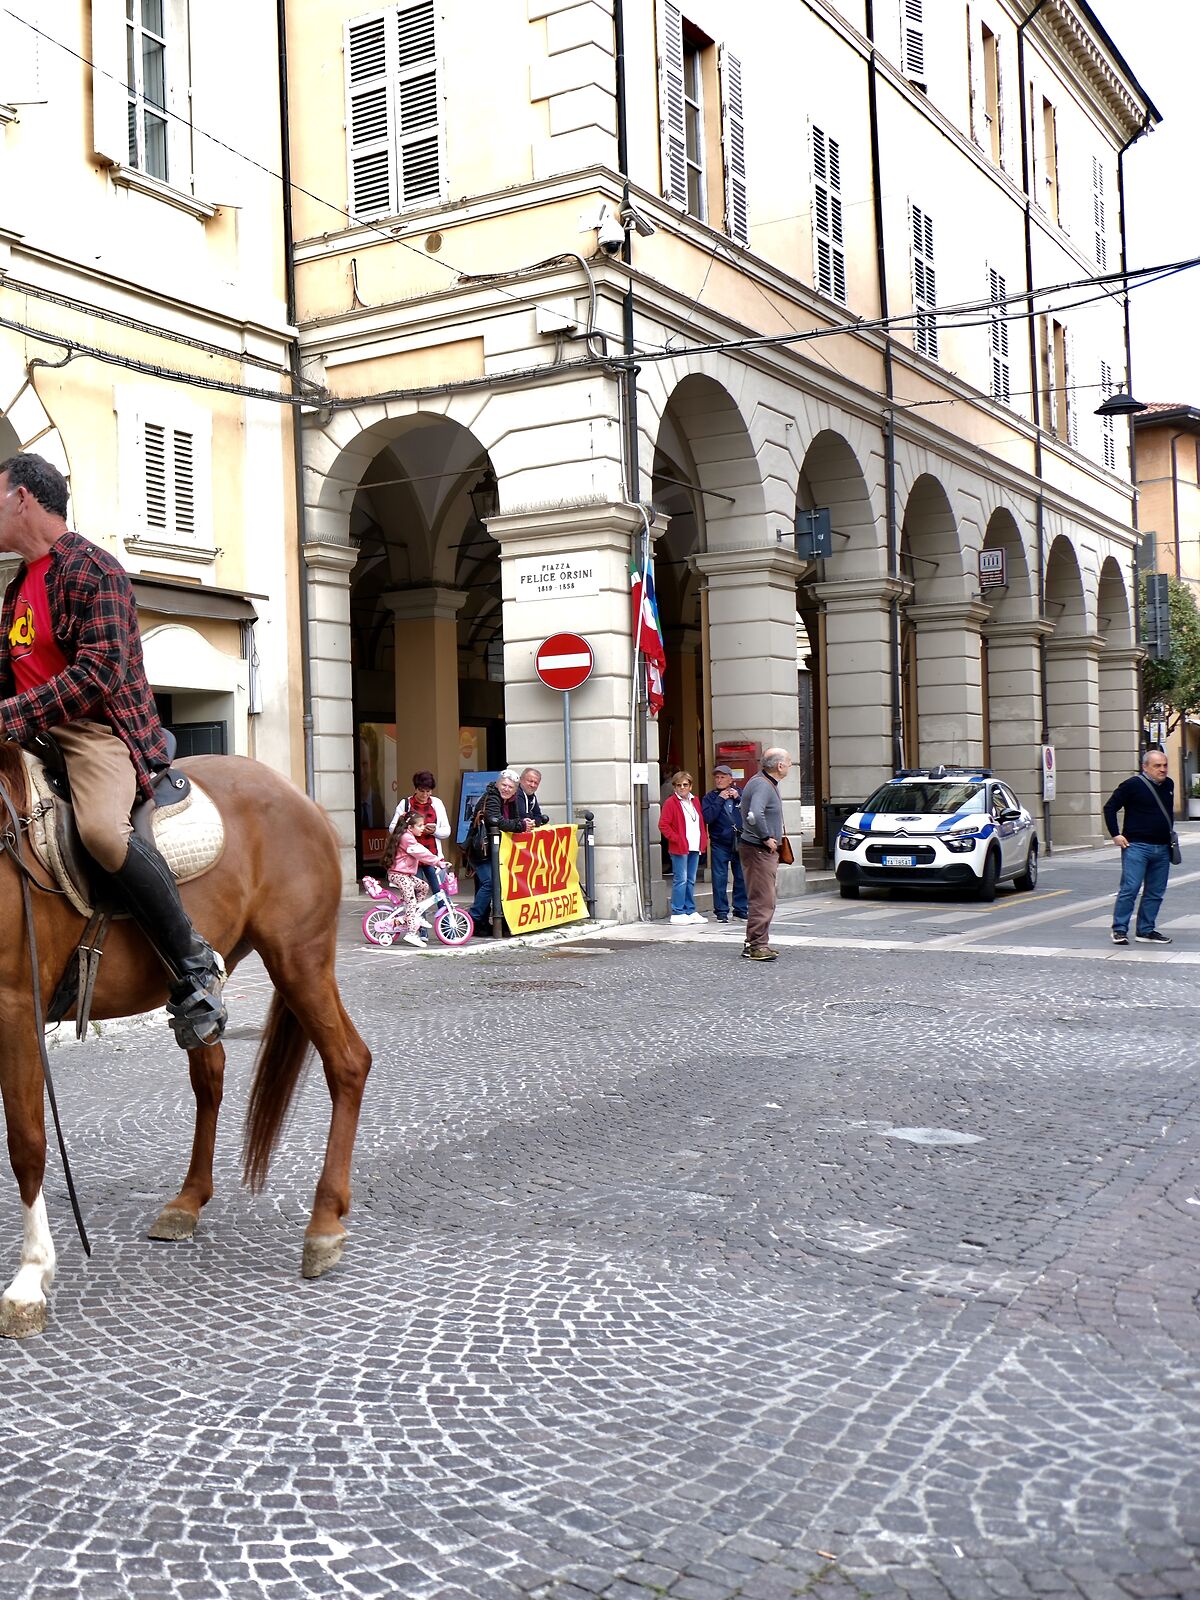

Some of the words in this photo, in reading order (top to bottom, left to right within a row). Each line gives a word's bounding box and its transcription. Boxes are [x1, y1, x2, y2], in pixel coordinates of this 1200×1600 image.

[541, 563, 570, 571] PIAZZA
[520, 573, 556, 584] FELICE
[560, 569, 593, 580] ORSINI
[559, 582, 575, 590] 1858
[518, 892, 578, 927] BATTERIE
